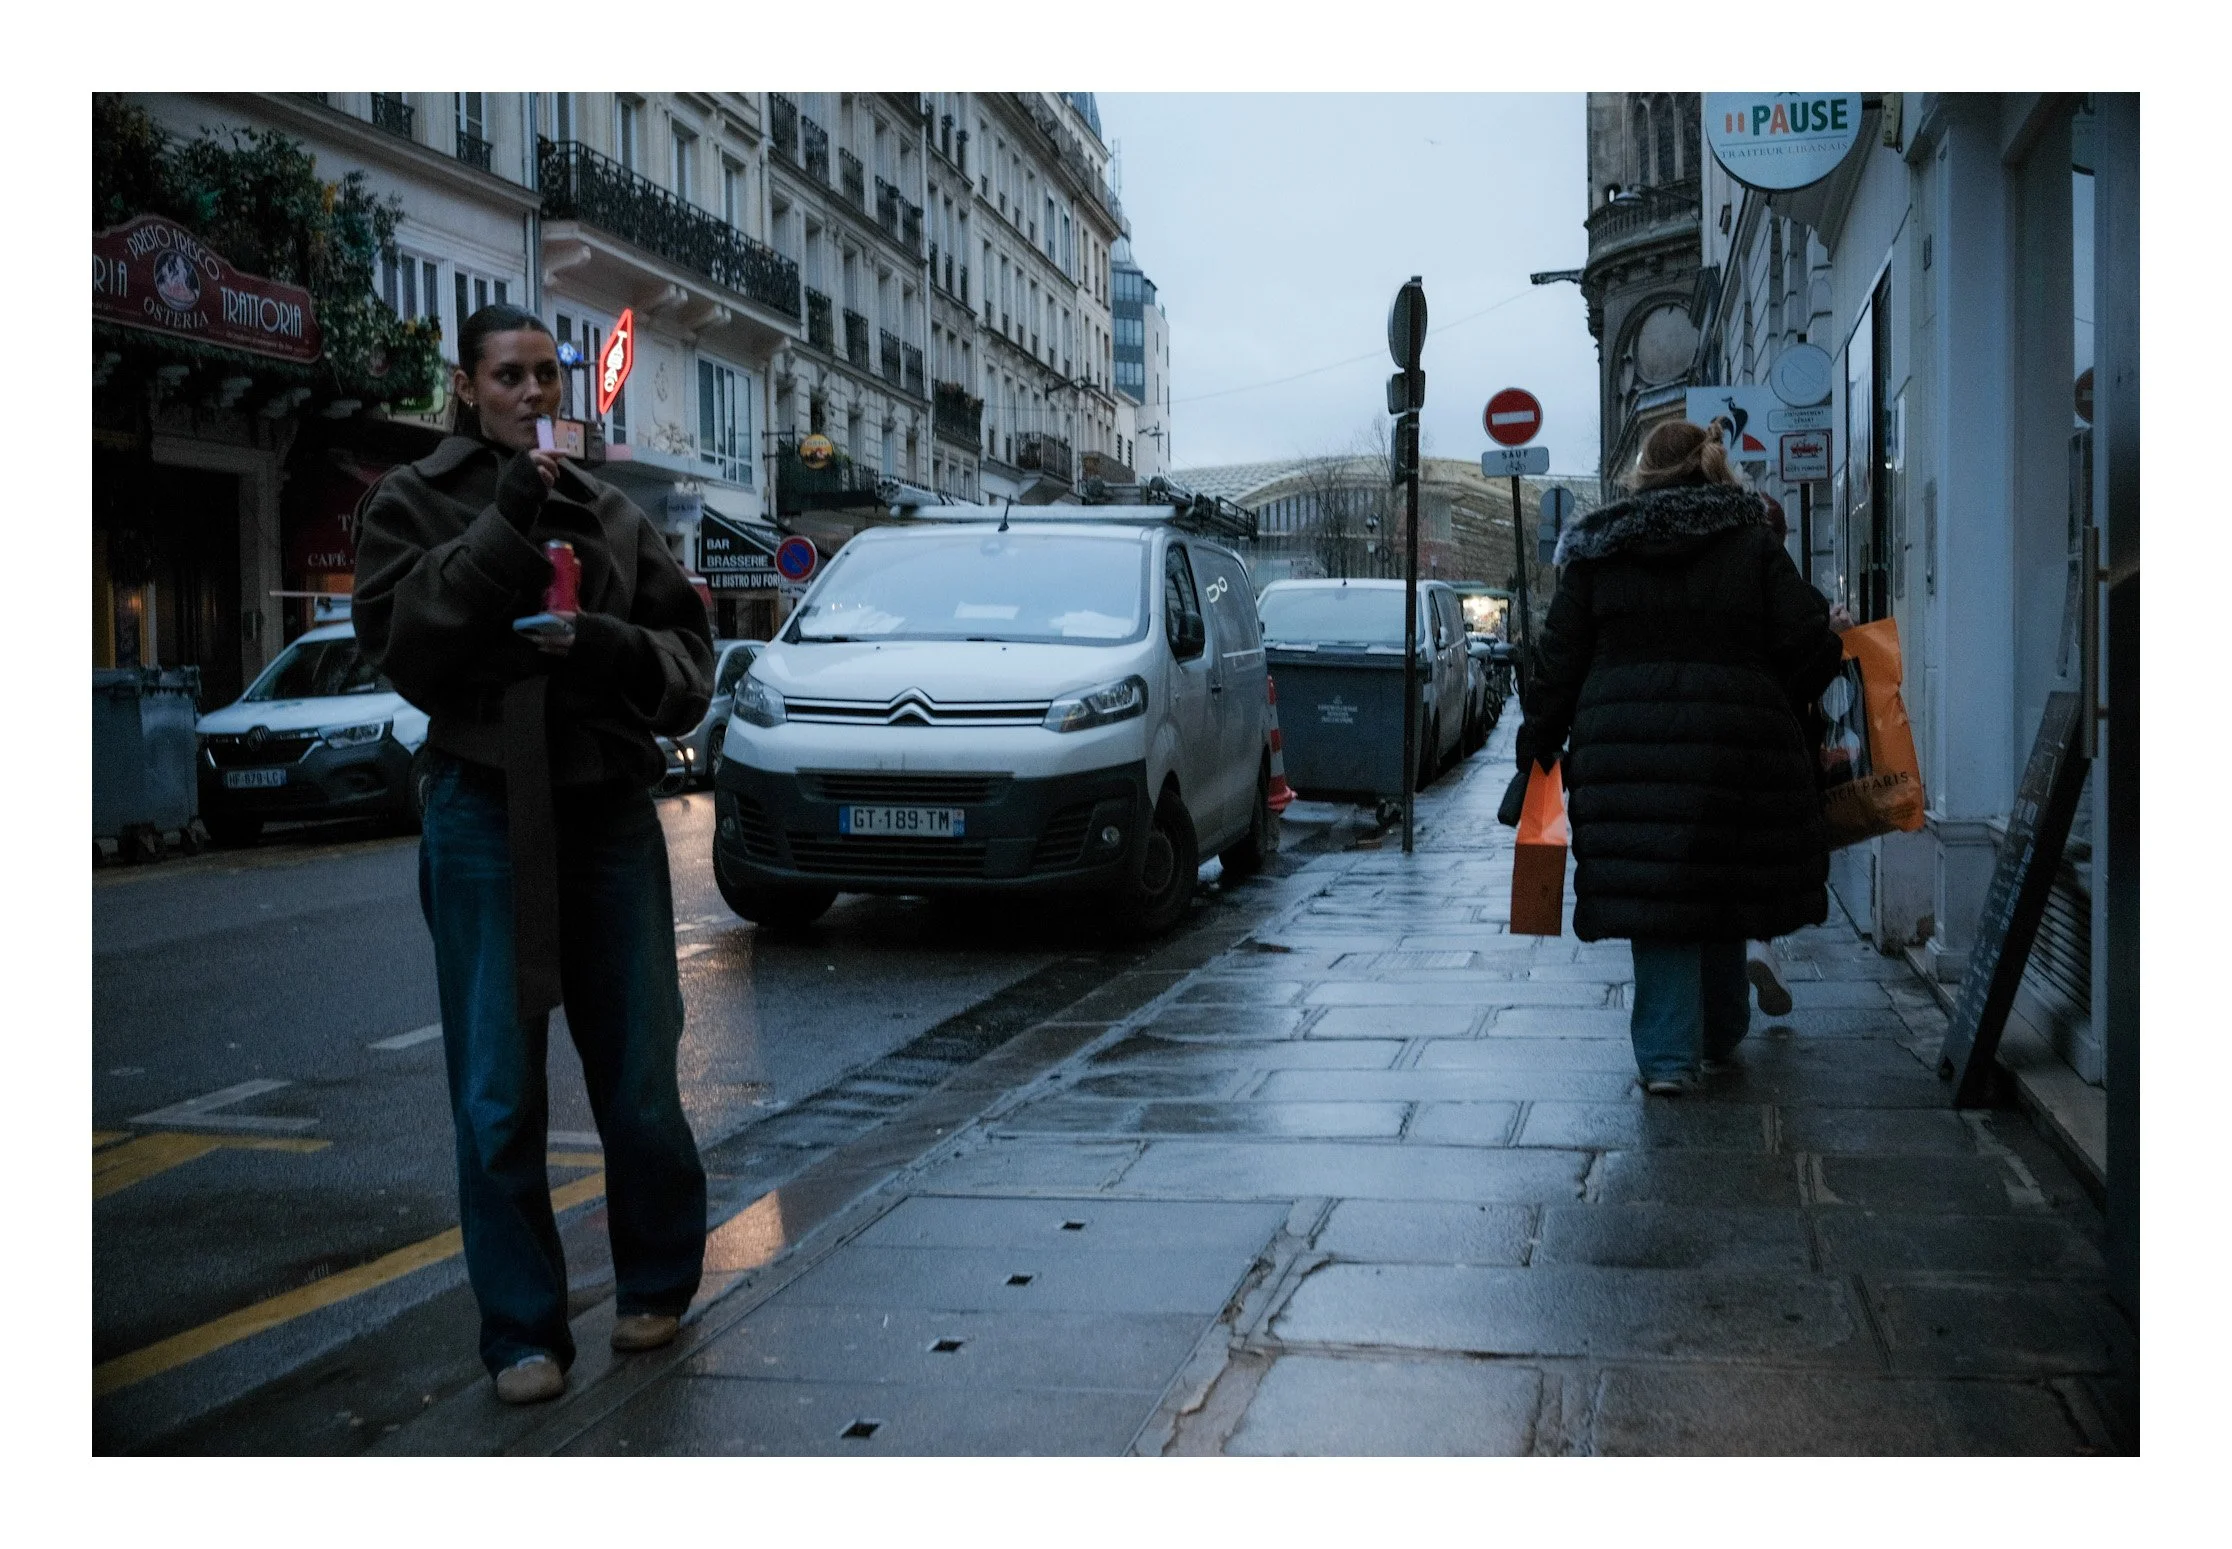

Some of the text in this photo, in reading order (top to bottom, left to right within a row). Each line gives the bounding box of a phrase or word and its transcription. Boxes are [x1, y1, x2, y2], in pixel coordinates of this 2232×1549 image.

[1752, 98, 1848, 136] PAUSE
[1720, 142, 1848, 160] TRAITEUR LIBANAIS
[126, 223, 220, 281] PRESTO FRESCO
[143, 296, 209, 329] OSTERIA
[220, 286, 302, 339] TRATTORIA
[1501, 450, 1528, 459] SAUF
[706, 537, 730, 550] BAR
[307, 550, 347, 568] CAFÉ
[706, 554, 768, 568] BRASSERIE
[711, 574, 721, 587] LE
[722, 574, 750, 587] BISTRO
[751, 574, 762, 587] DU
[1862, 771, 1908, 792] PARIS
[854, 809, 950, 831] GT-189-TM
